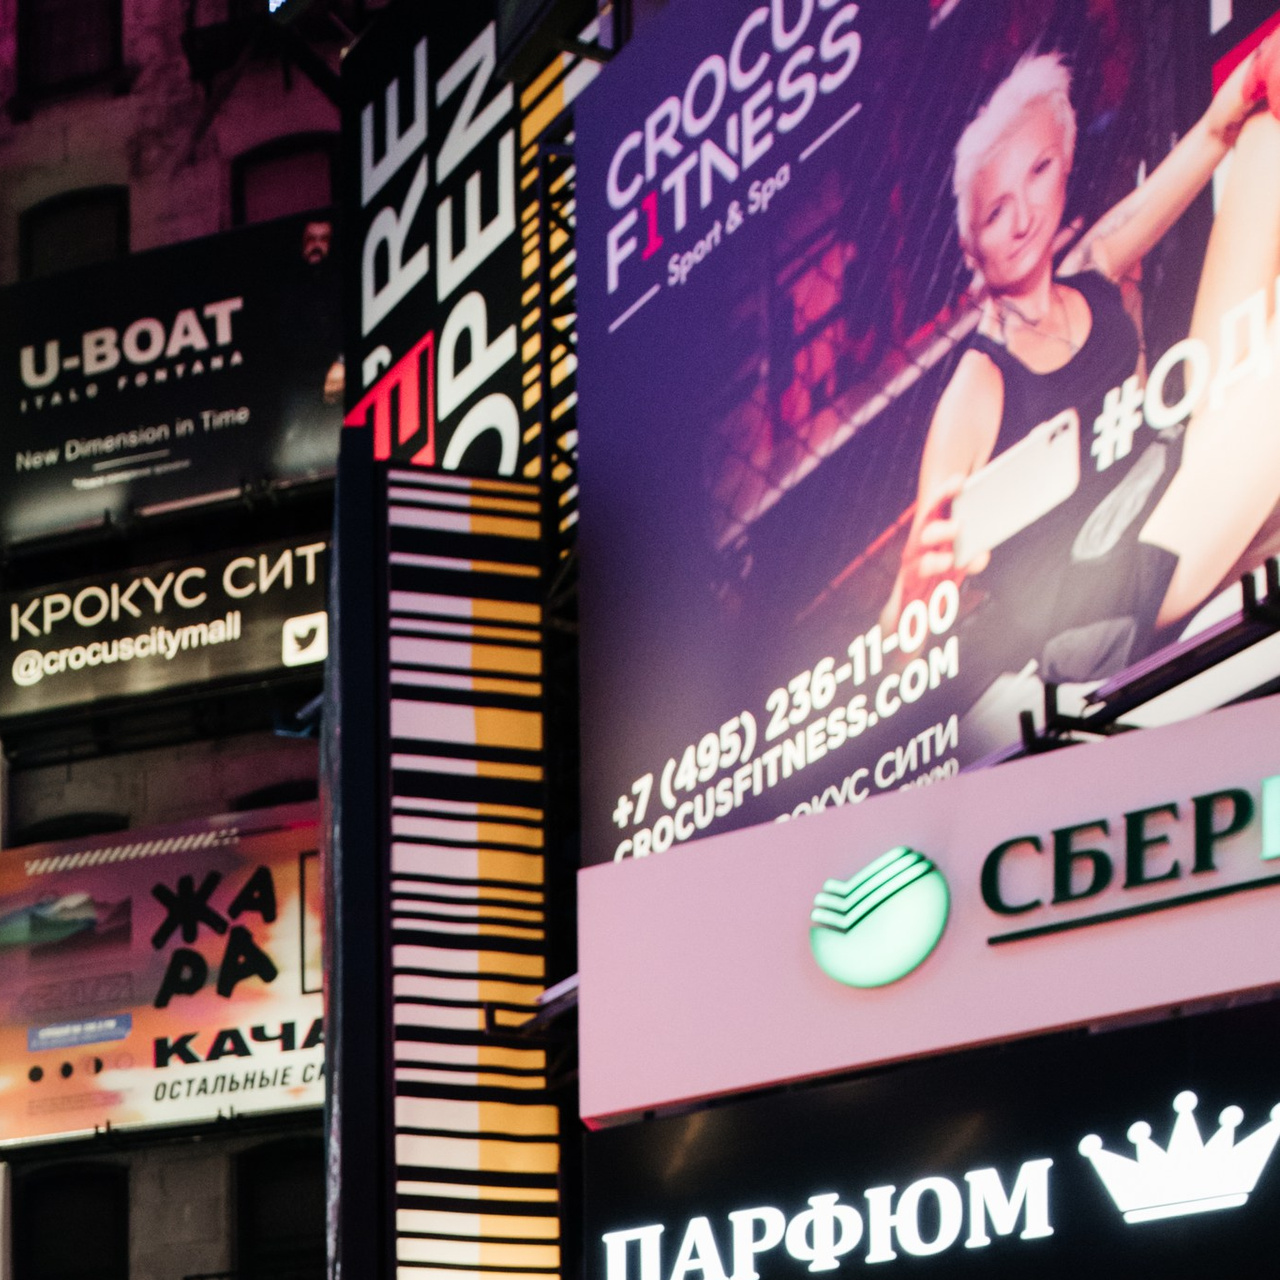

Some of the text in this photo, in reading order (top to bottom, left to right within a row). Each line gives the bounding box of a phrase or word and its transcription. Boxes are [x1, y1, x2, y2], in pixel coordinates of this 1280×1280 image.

[606, 0, 842, 211] CROCU
[667, 162, 791, 287] Sport & Spa
[19, 295, 245, 391] U-BOAT
[1090, 275, 1280, 473] #ОД
[19, 349, 245, 415] ITALO FONTANA
[15, 405, 252, 473] New Dimension in Time
[10, 567, 208, 641] КРОКУС
[11, 610, 242, 687] @crocuscitymall
[613, 580, 960, 850] +7 (495) 236-11-00
[874, 713, 960, 789] СИТИ
[153, 1066, 294, 1102] ОСТАЛЬНЫЕ
